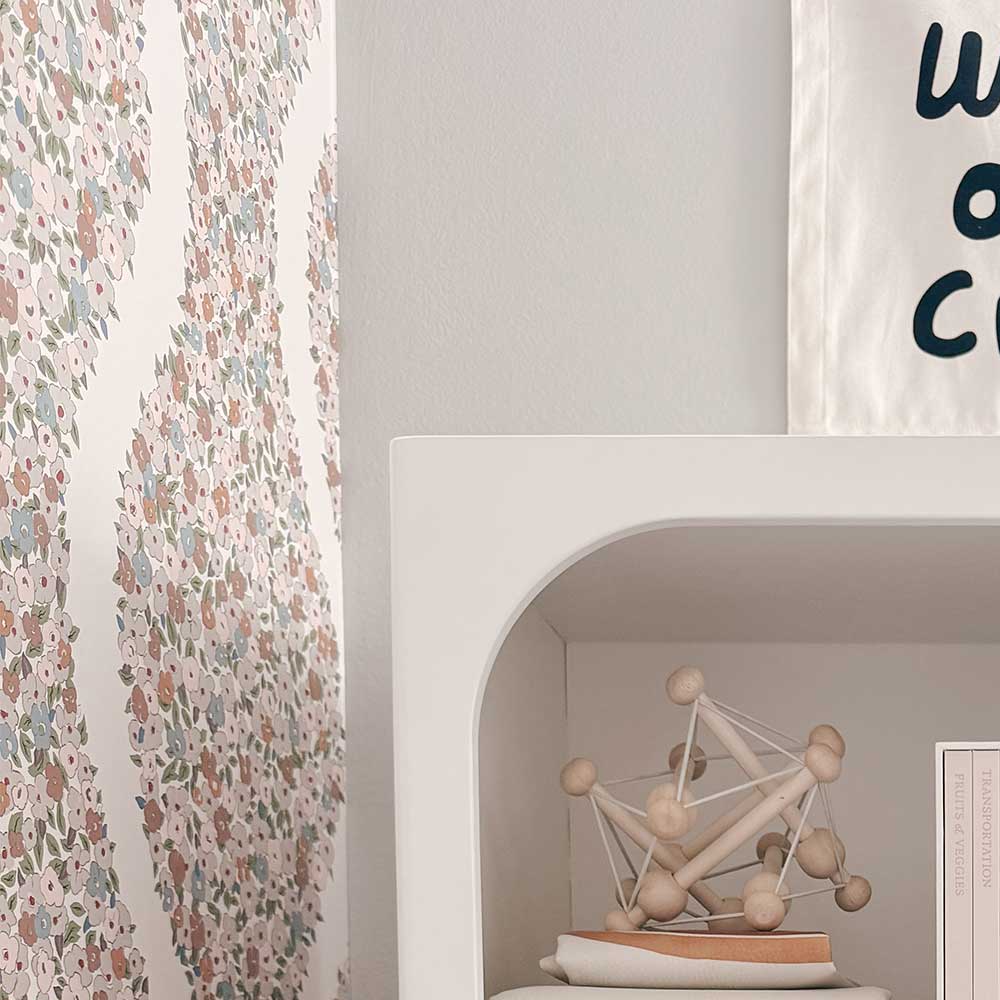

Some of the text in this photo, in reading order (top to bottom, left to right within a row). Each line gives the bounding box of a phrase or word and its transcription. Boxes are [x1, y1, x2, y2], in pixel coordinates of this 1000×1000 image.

[954, 773, 965, 820] FRUITS
[981, 769, 992, 888] TRANSPORTATION
[954, 839, 965, 897] VEGGIES
